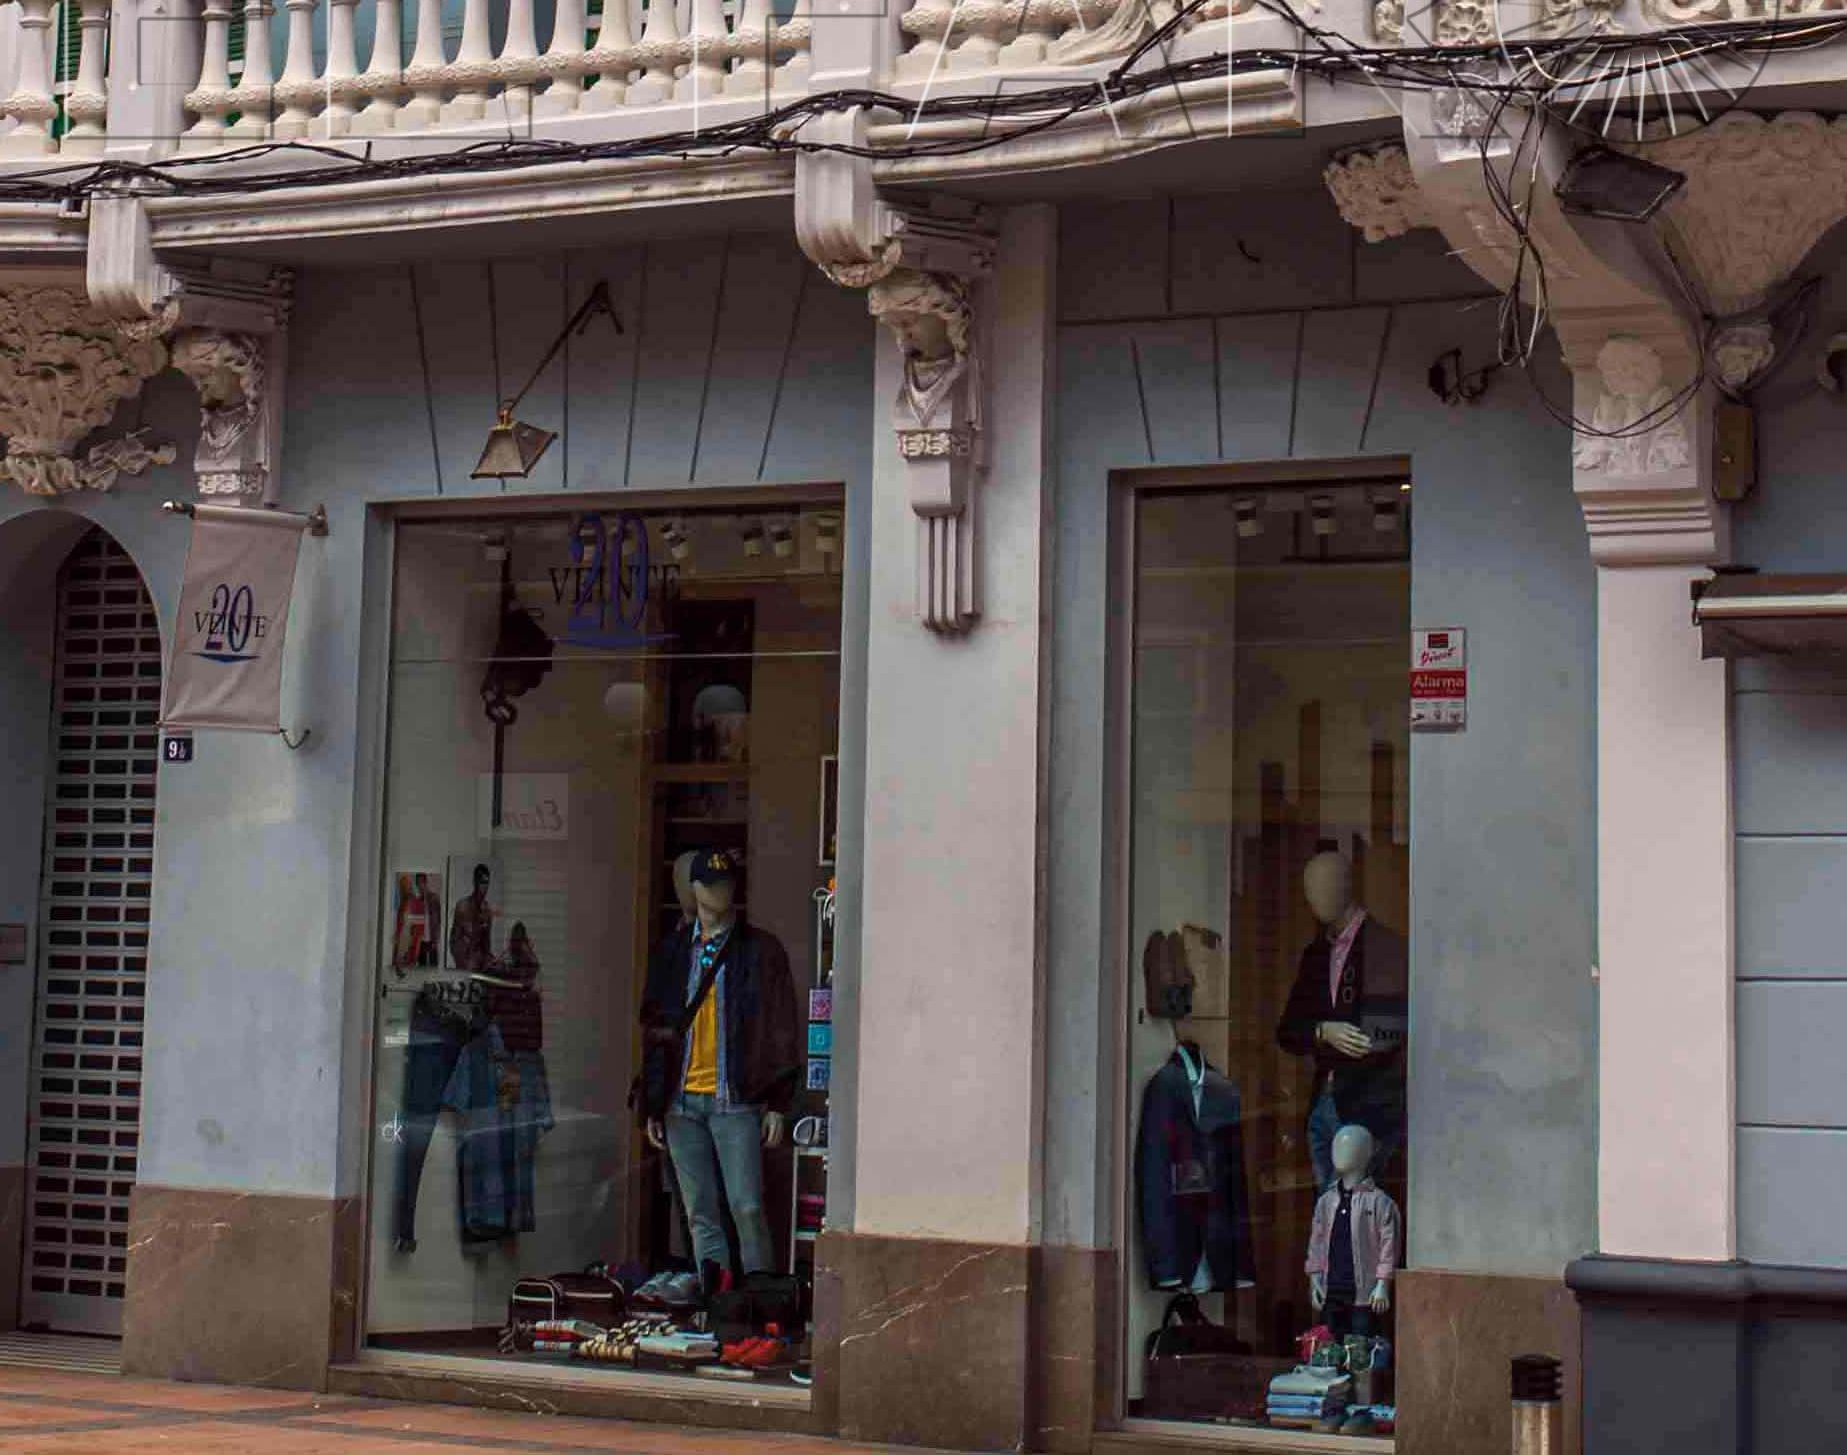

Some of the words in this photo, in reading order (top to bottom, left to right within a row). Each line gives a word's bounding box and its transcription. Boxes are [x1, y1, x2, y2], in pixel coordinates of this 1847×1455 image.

[205, 583, 254, 653] 20
[1413, 672, 1465, 691] Alarma
[168, 739, 179, 759] 9
